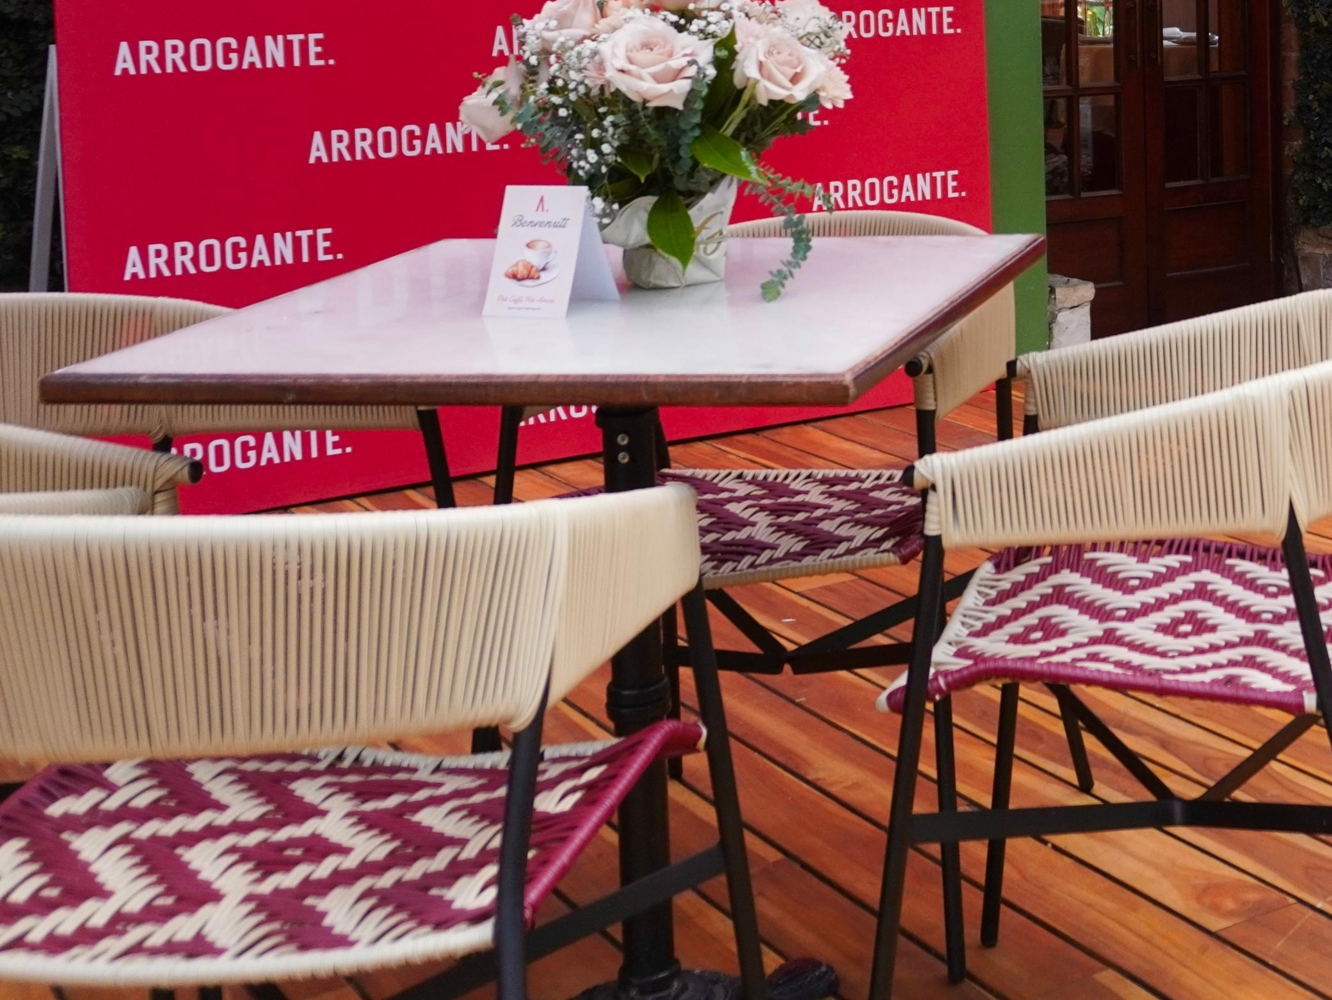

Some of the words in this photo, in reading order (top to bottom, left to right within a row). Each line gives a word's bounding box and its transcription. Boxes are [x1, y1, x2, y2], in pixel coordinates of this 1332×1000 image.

[841, 6, 962, 38] ROGANTE.
[114, 33, 335, 75] ARROGANTE.
[812, 170, 966, 211] ARROGANTE.
[511, 214, 570, 228] Benvenuti
[123, 228, 344, 280] ARROGANTE.
